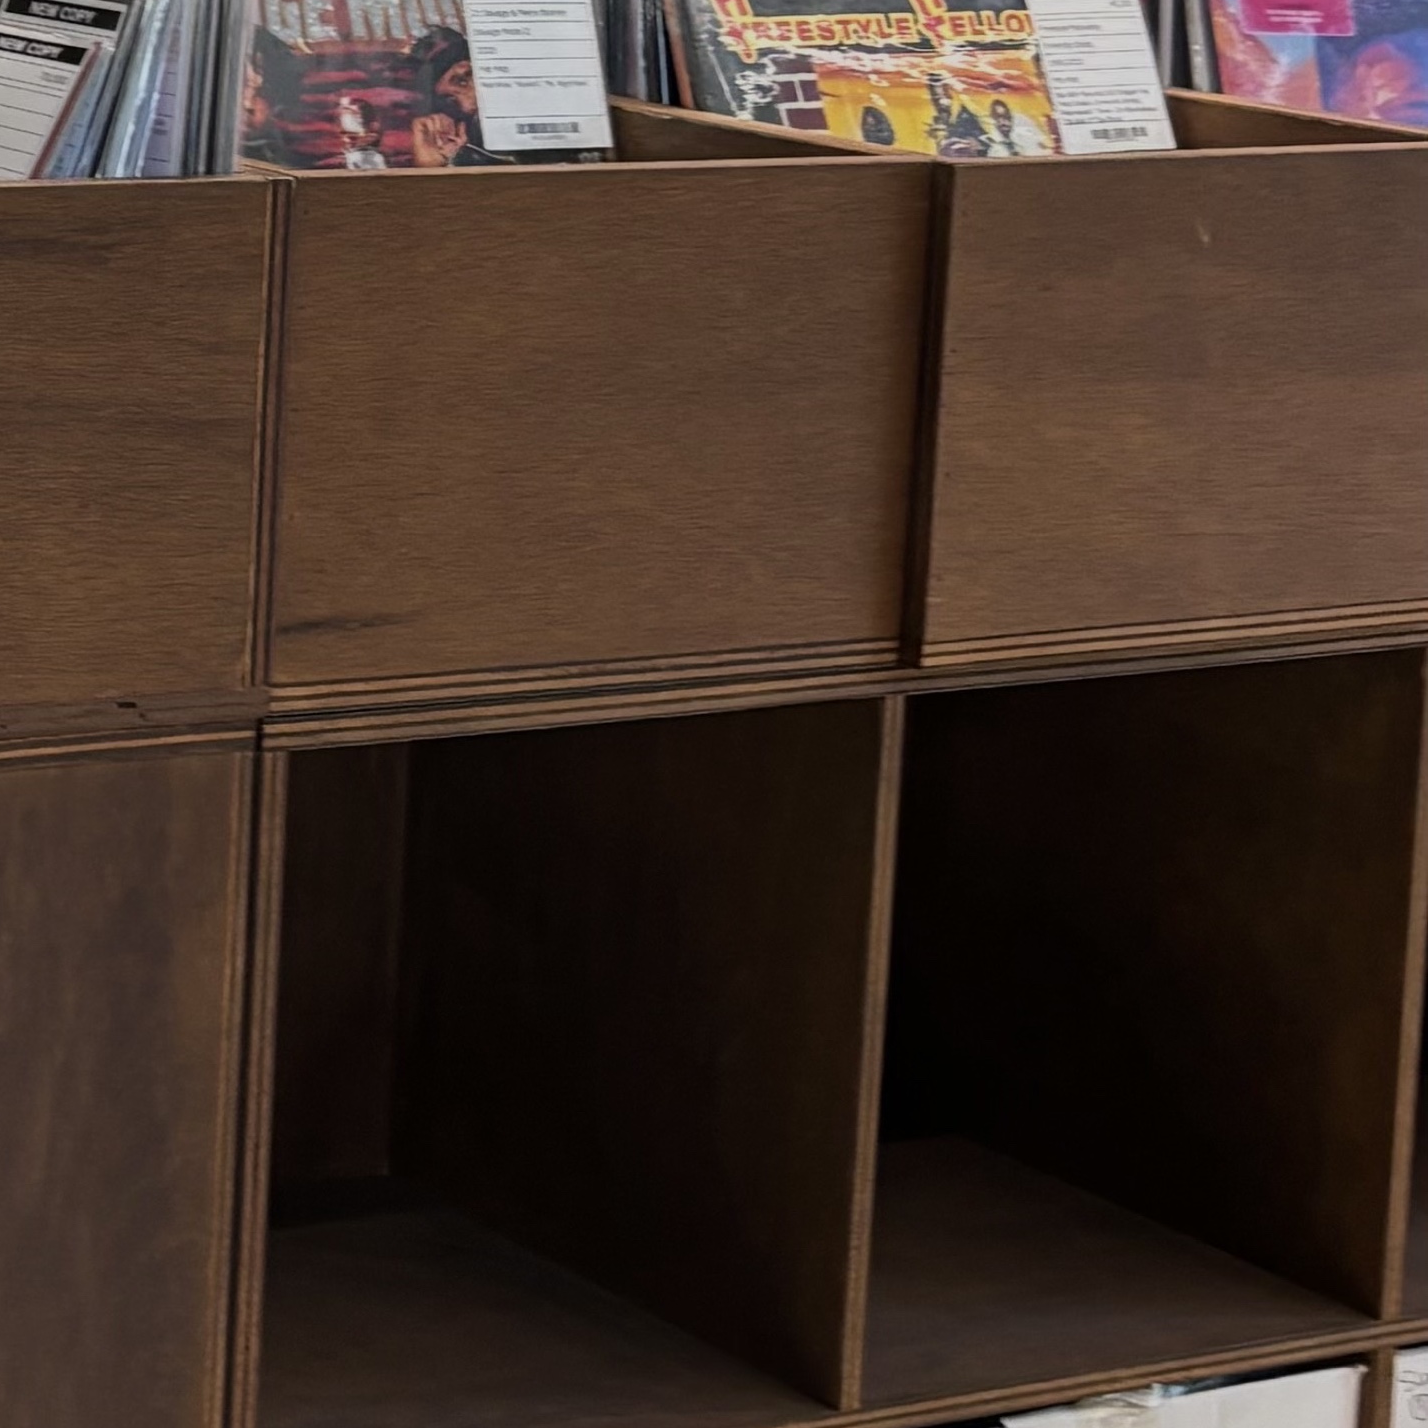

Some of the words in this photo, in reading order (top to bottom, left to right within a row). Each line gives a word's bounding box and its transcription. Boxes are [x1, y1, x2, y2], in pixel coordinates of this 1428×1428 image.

[28, 0, 60, 18] NEW
[59, 5, 98, 25] COPY
[26, 42, 65, 60] COPY
